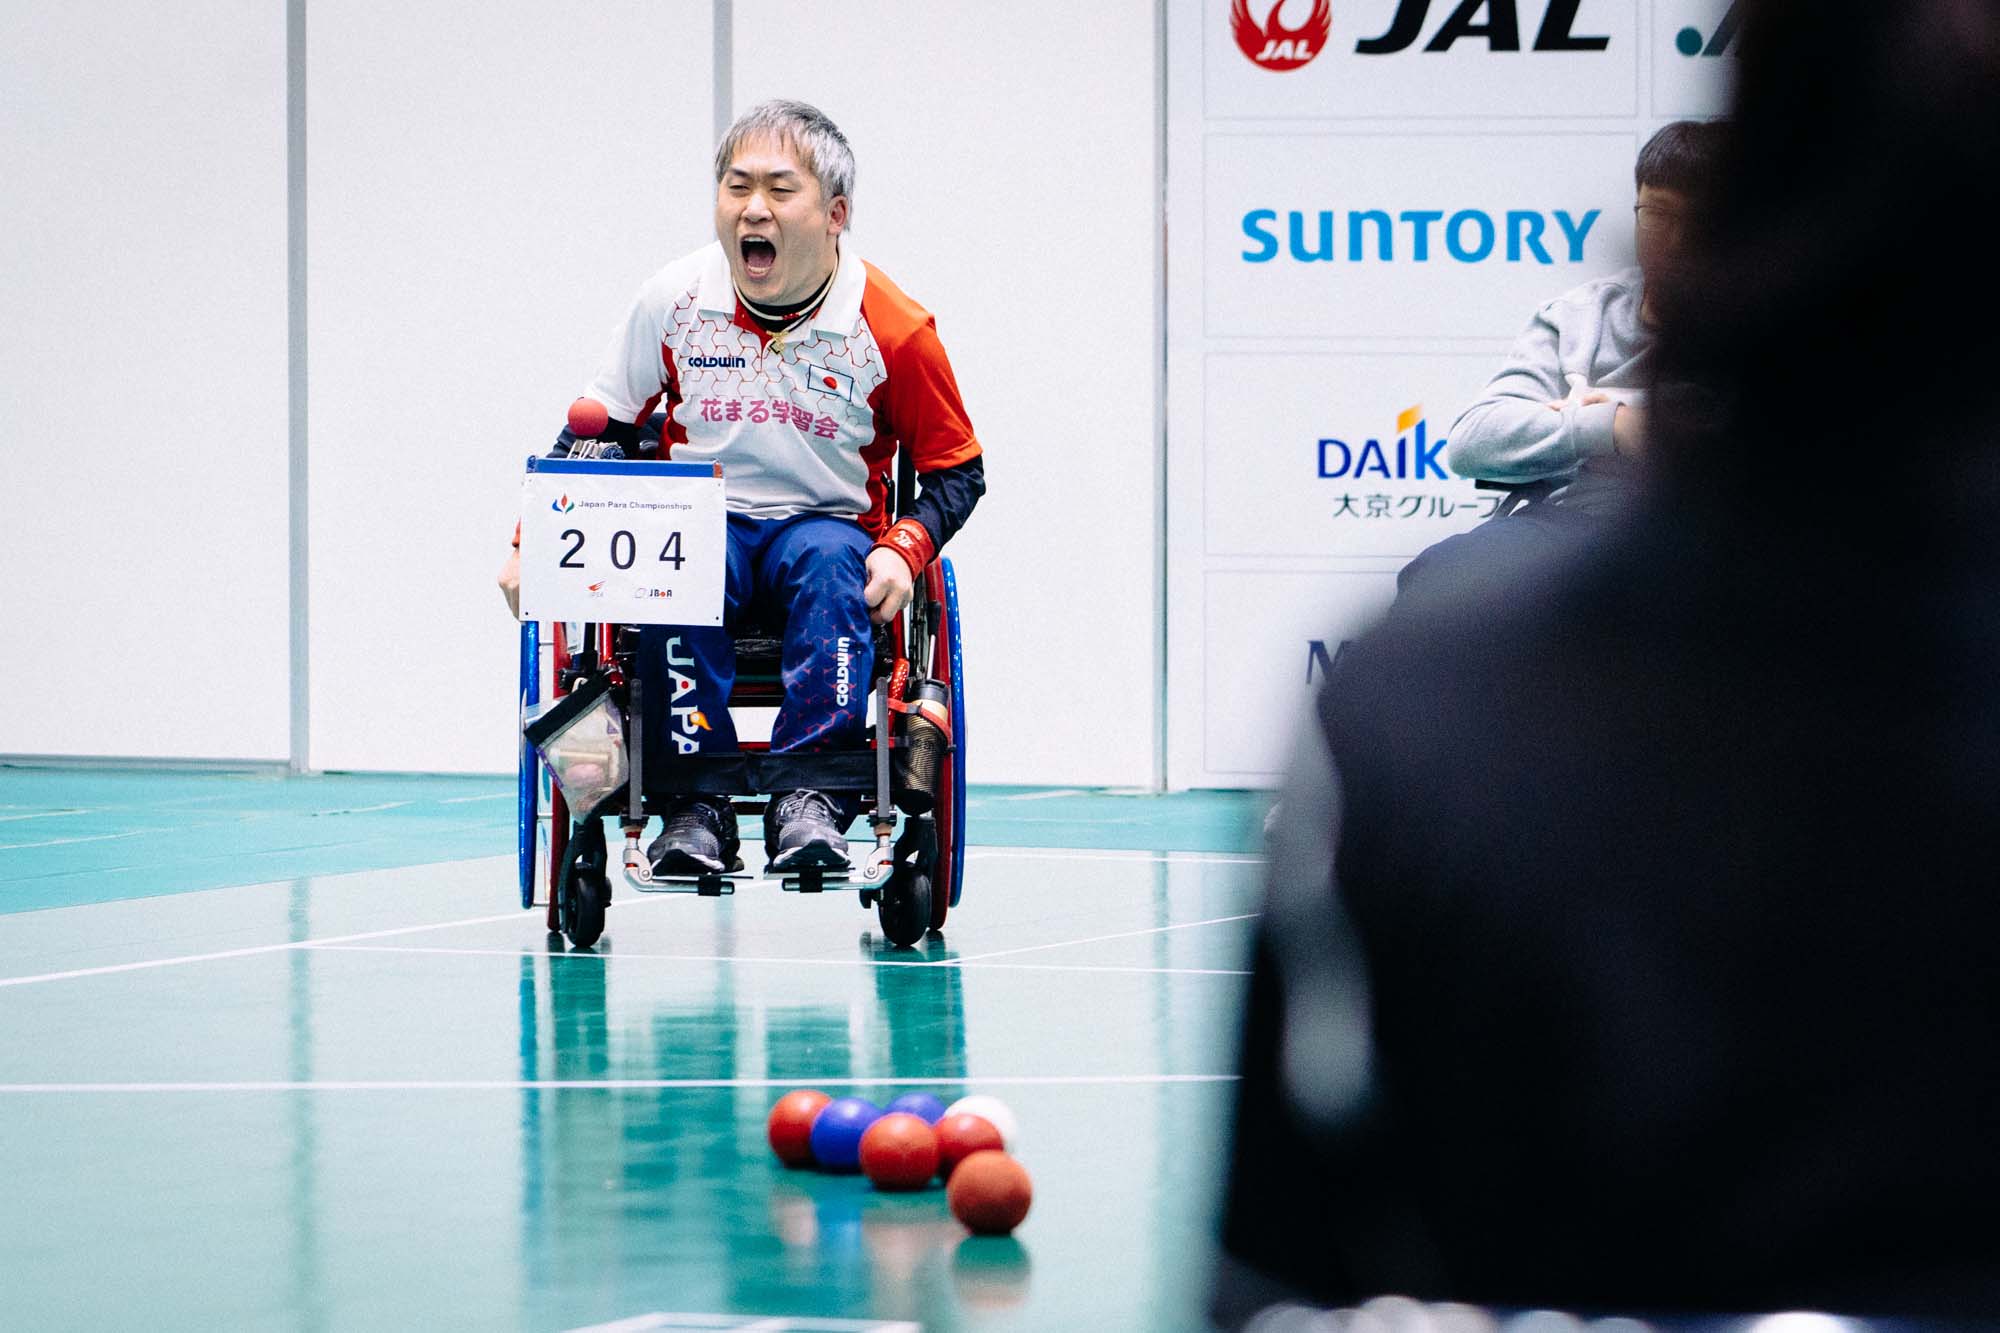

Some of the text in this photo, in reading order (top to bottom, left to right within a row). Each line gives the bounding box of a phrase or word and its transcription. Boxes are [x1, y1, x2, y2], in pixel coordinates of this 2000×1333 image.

[1354, 0, 1611, 55] JAL
[1256, 39, 1313, 61] JAL
[1241, 208, 1601, 265] SUNTORY
[700, 399, 840, 440] 花まる学習会
[578, 501, 693, 511] Japan Para Championships
[1332, 493, 1504, 519] 大京グループ
